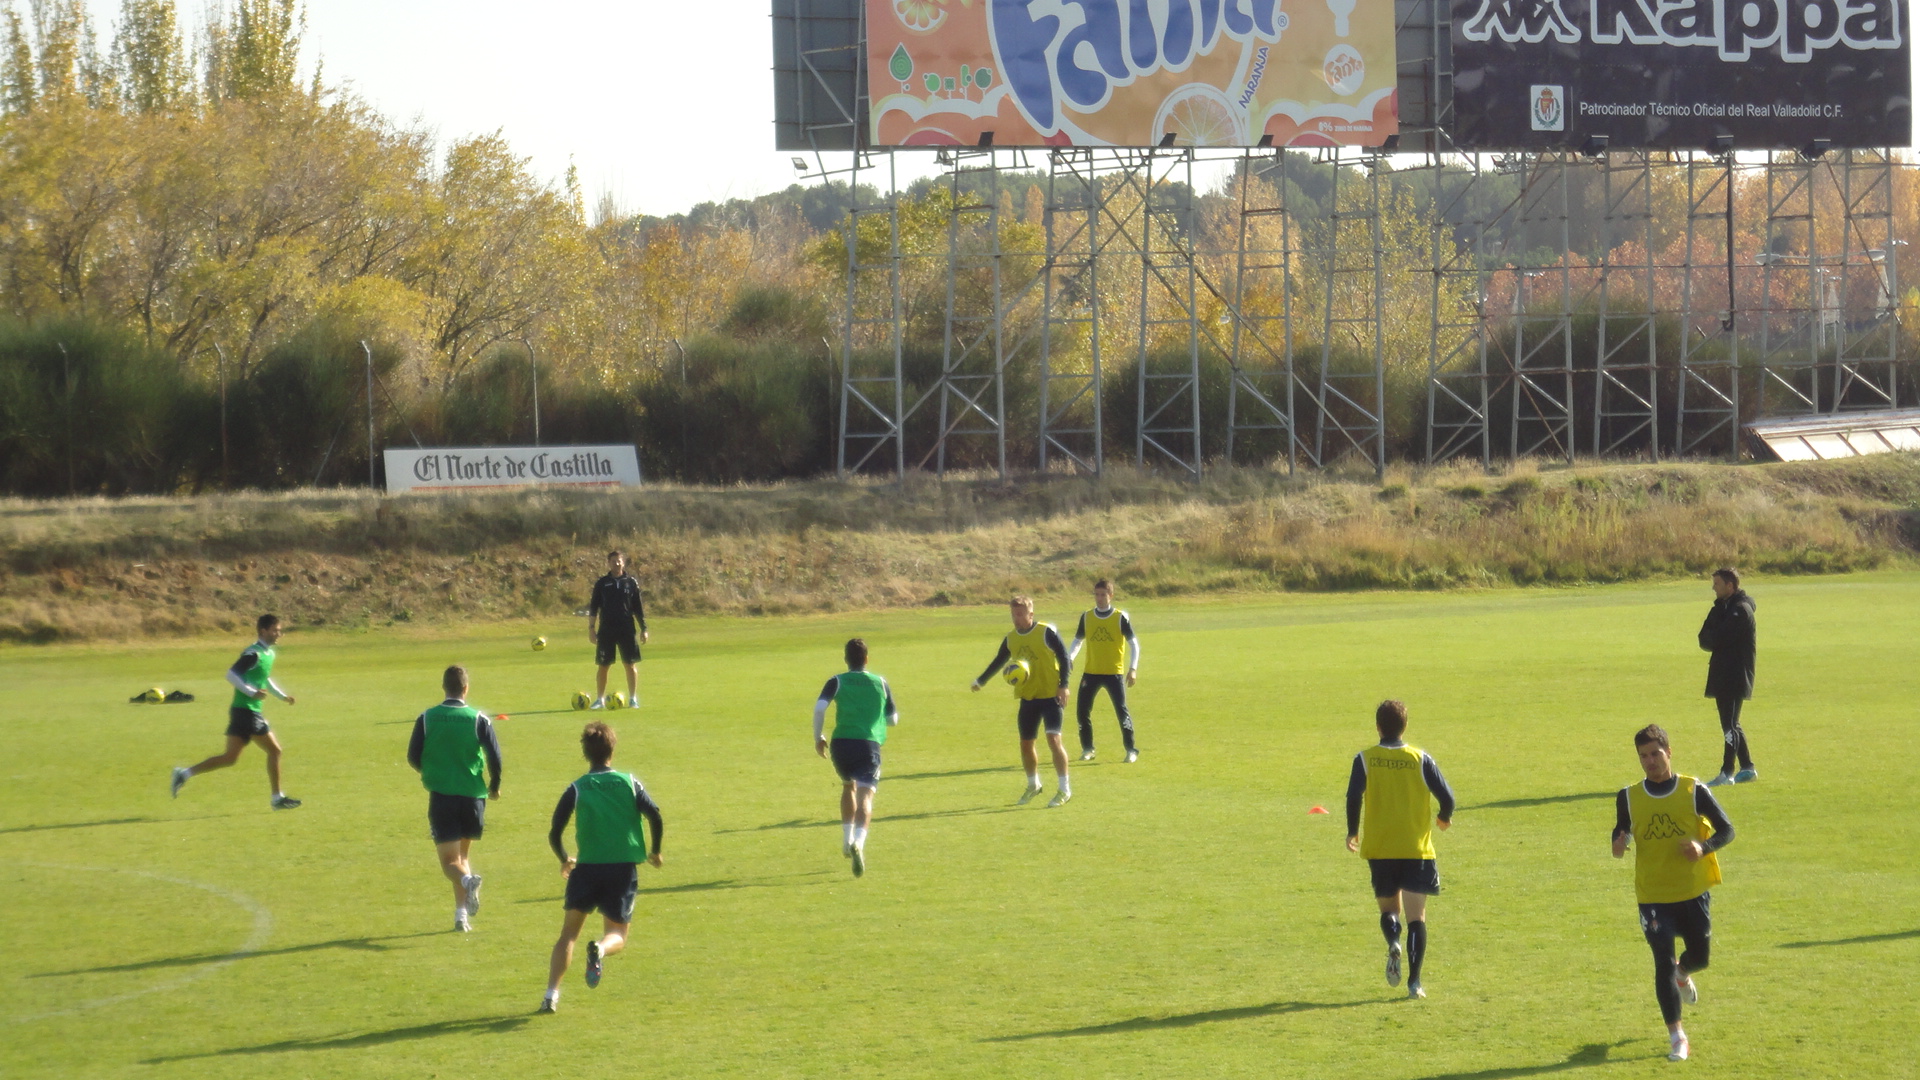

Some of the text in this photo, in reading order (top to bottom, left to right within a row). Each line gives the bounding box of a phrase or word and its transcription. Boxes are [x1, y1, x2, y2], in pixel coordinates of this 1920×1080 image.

[1591, 0, 1901, 62] Kappa
[1238, 47, 1269, 109] NARANJA
[1325, 53, 1363, 86] Fanta
[1580, 102, 1843, 118] Patrocinador Técnico Oficial del Real Valladolid C.F.
[413, 452, 614, 482] El Norte de Castilla
[1370, 757, 1416, 770] Kappa
[1650, 909, 1657, 918] 9
